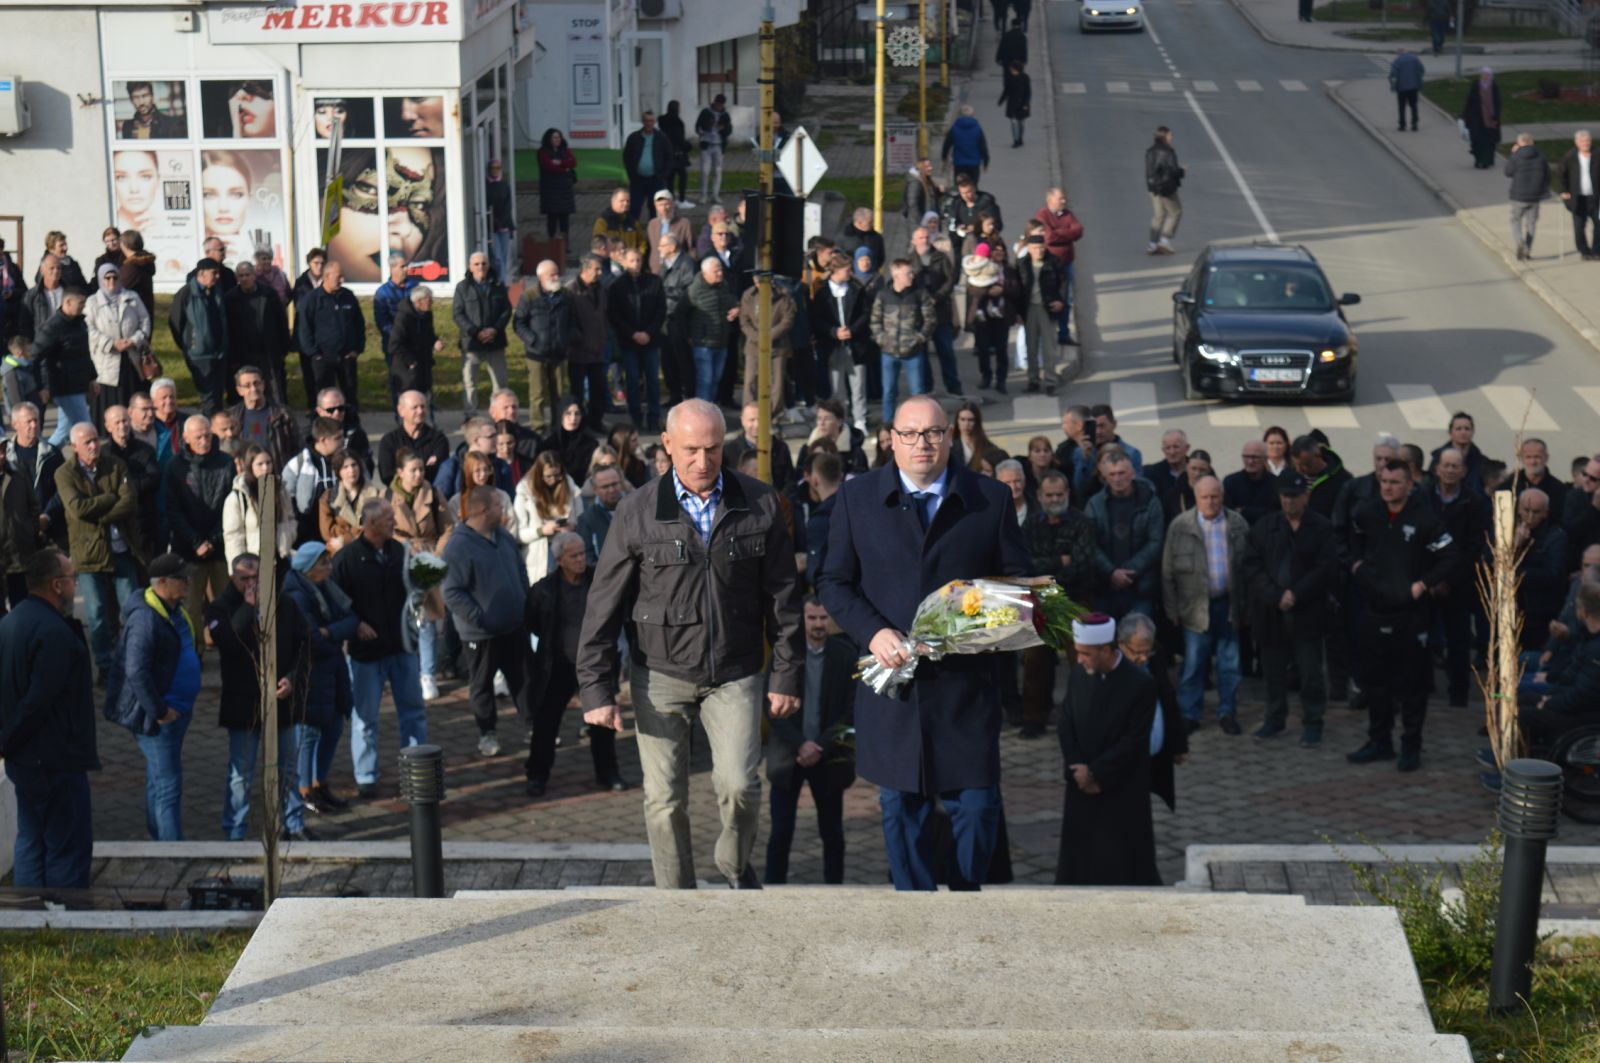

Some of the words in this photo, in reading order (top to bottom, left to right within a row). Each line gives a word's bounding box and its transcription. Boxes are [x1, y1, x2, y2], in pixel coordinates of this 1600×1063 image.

[262, 2, 449, 29] MERKUR
[572, 19, 600, 28] STOP
[164, 182, 189, 197] NUDE
[165, 196, 190, 209] LOOK
